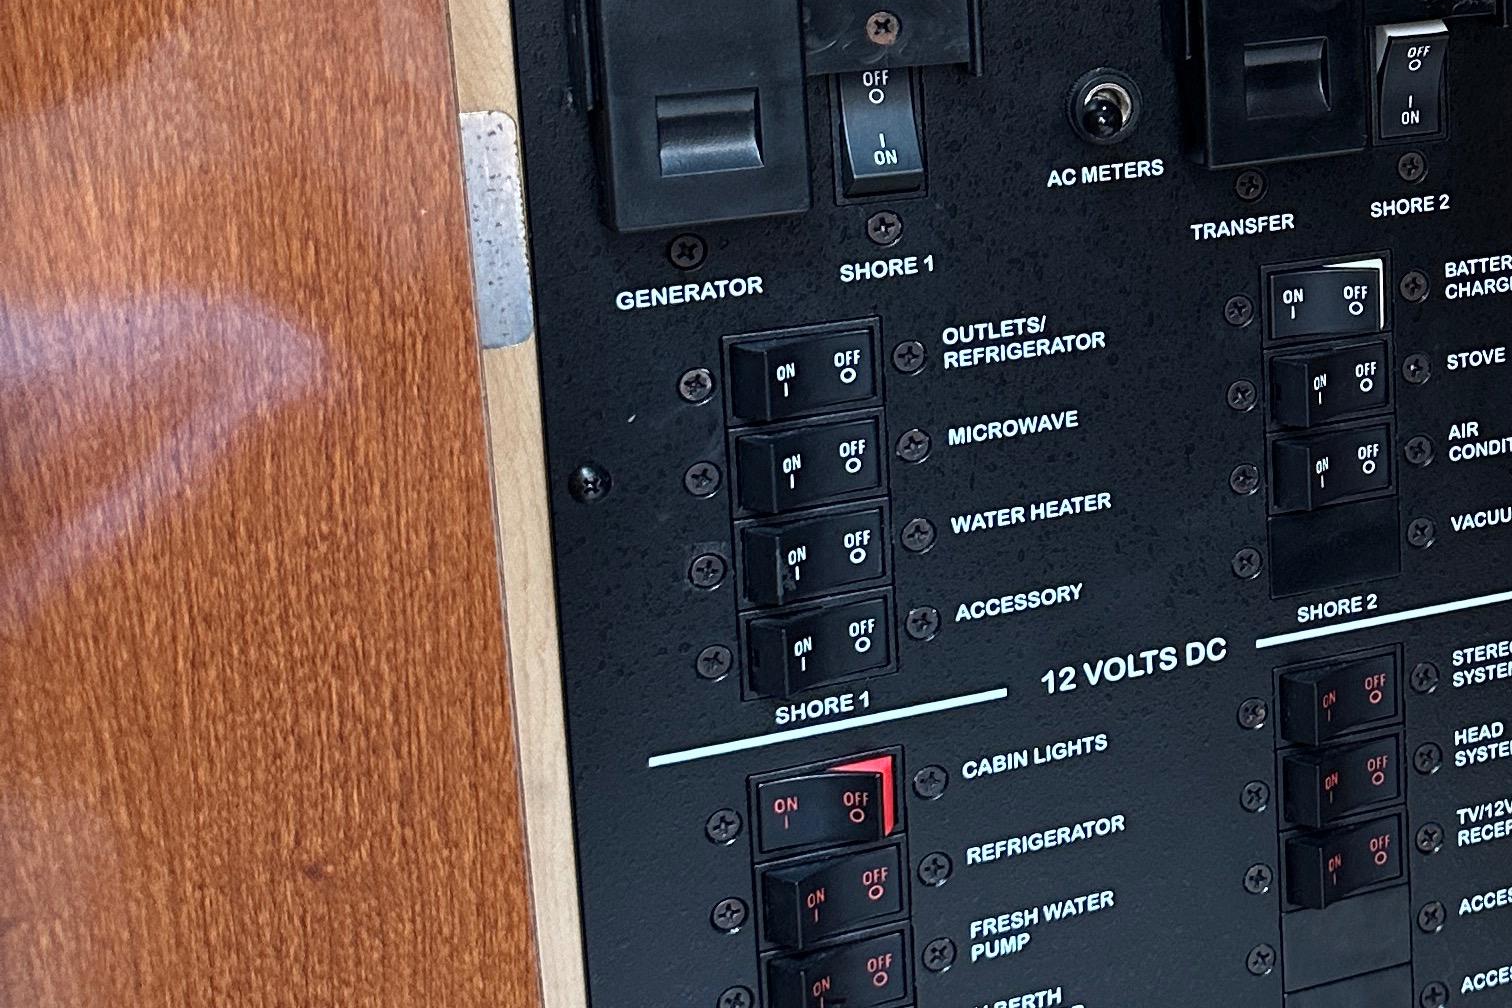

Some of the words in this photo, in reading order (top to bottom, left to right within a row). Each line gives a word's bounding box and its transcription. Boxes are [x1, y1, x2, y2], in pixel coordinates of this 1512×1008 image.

[863, 70, 889, 86] OFF
[874, 150, 898, 166] ON
[1047, 169, 1077, 188] AC
[1081, 159, 1165, 184] METERS
[1370, 196, 1435, 219] SHORE
[1438, 194, 1450, 210] 2
[1190, 213, 1295, 241] TRANSFER
[839, 257, 918, 283] SHORE
[924, 255, 935, 272] 1
[615, 276, 763, 310] GENERATOR
[942, 315, 1046, 346] OUTLETS/
[834, 350, 861, 368] OFF
[943, 331, 1106, 370] REFRIGERATOR
[1447, 347, 1506, 370] STOVE
[776, 363, 795, 381] ON
[947, 410, 1079, 446] MICROWAVE
[1448, 421, 1479, 440] AIR
[950, 507, 1026, 534] WATER
[1030, 492, 1112, 521] HEATER
[955, 583, 1084, 623] ACCESSORY
[1297, 597, 1363, 623] SHORE
[1366, 594, 1378, 610] 2
[1041, 667, 1076, 694] 12
[1082, 646, 1177, 686] VOLTS
[1185, 637, 1227, 666] DC
[774, 694, 855, 726] SHORE
[859, 691, 870, 708] 1
[1454, 721, 1504, 746] HEAD
[961, 751, 1028, 780] CABIN
[1033, 734, 1108, 765] LIGHTS
[773, 797, 798, 813] ON
[843, 791, 869, 808] OFF
[966, 815, 1126, 865] REFRIGERATOR
[970, 909, 1039, 940] FRESH
[1042, 890, 1115, 922] WATER
[970, 934, 1031, 964] PUMP
